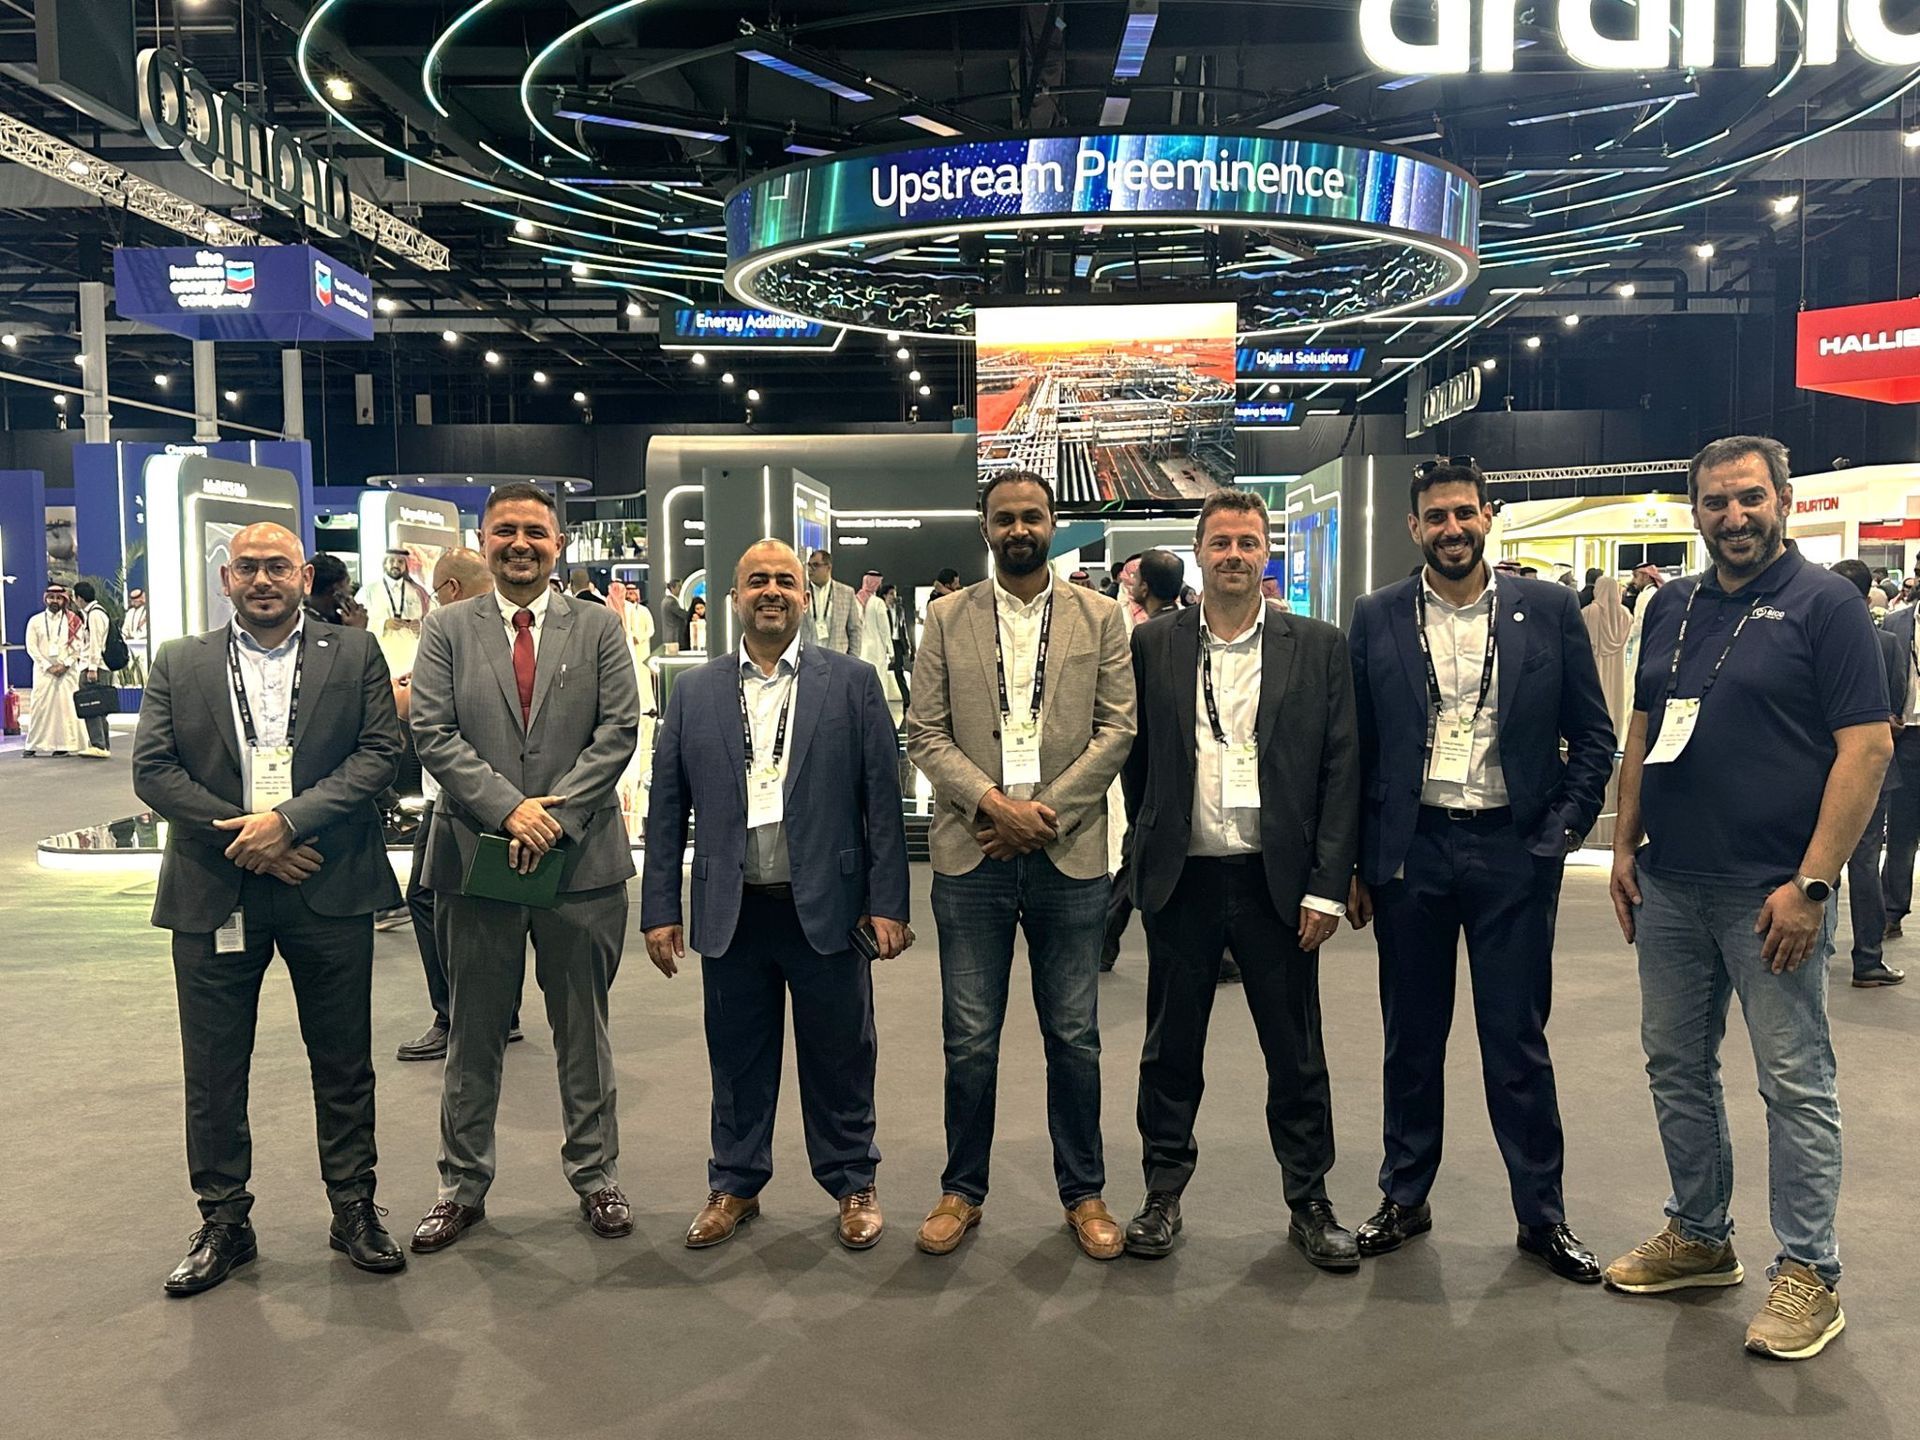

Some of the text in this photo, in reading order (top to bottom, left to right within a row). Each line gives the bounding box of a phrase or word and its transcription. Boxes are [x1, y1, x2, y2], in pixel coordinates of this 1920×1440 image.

[871, 148, 1345, 217] Upstream Preeminence
[696, 313, 807, 332] Energy Additions
[1819, 327, 1920, 356] HALLIB
[1256, 351, 1349, 367] Digital Solutions
